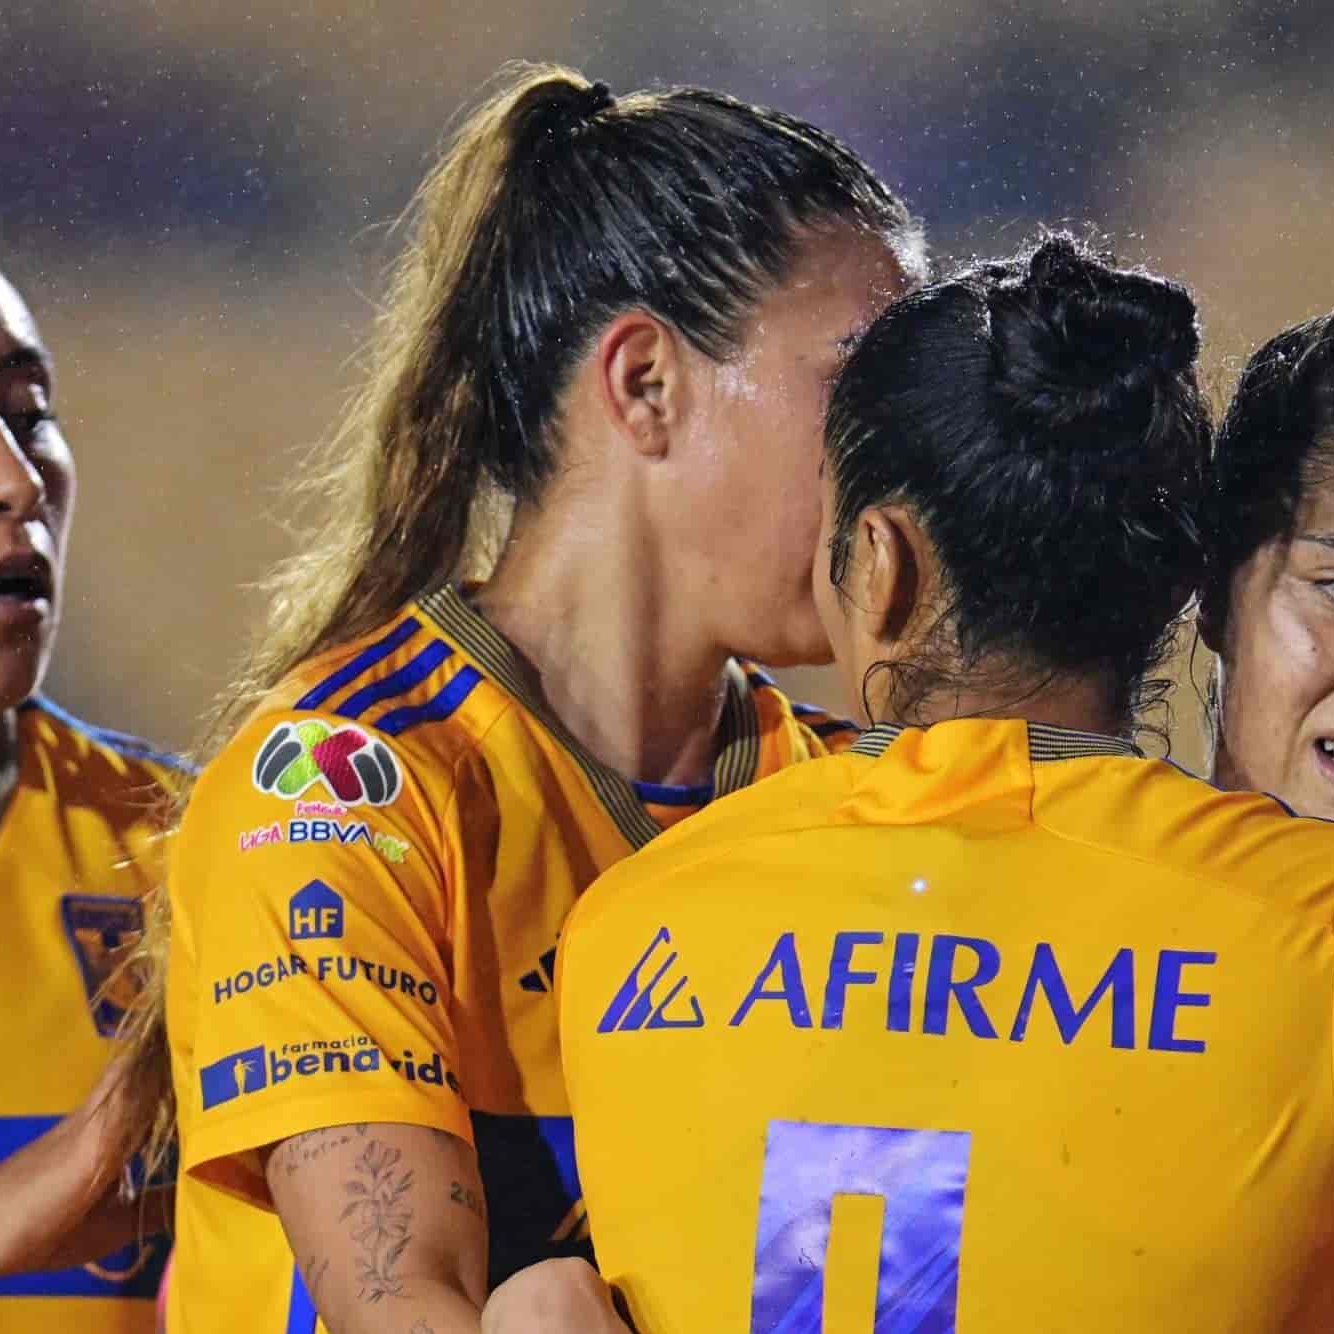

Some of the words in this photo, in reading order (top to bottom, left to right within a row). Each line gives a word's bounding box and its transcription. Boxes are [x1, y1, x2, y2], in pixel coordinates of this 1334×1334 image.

[289, 821, 372, 845] BBVA
[293, 907, 338, 935] HF
[214, 954, 308, 1004] HOGAR
[317, 957, 438, 1006] FUTURO
[729, 932, 1217, 1053] AFIRME
